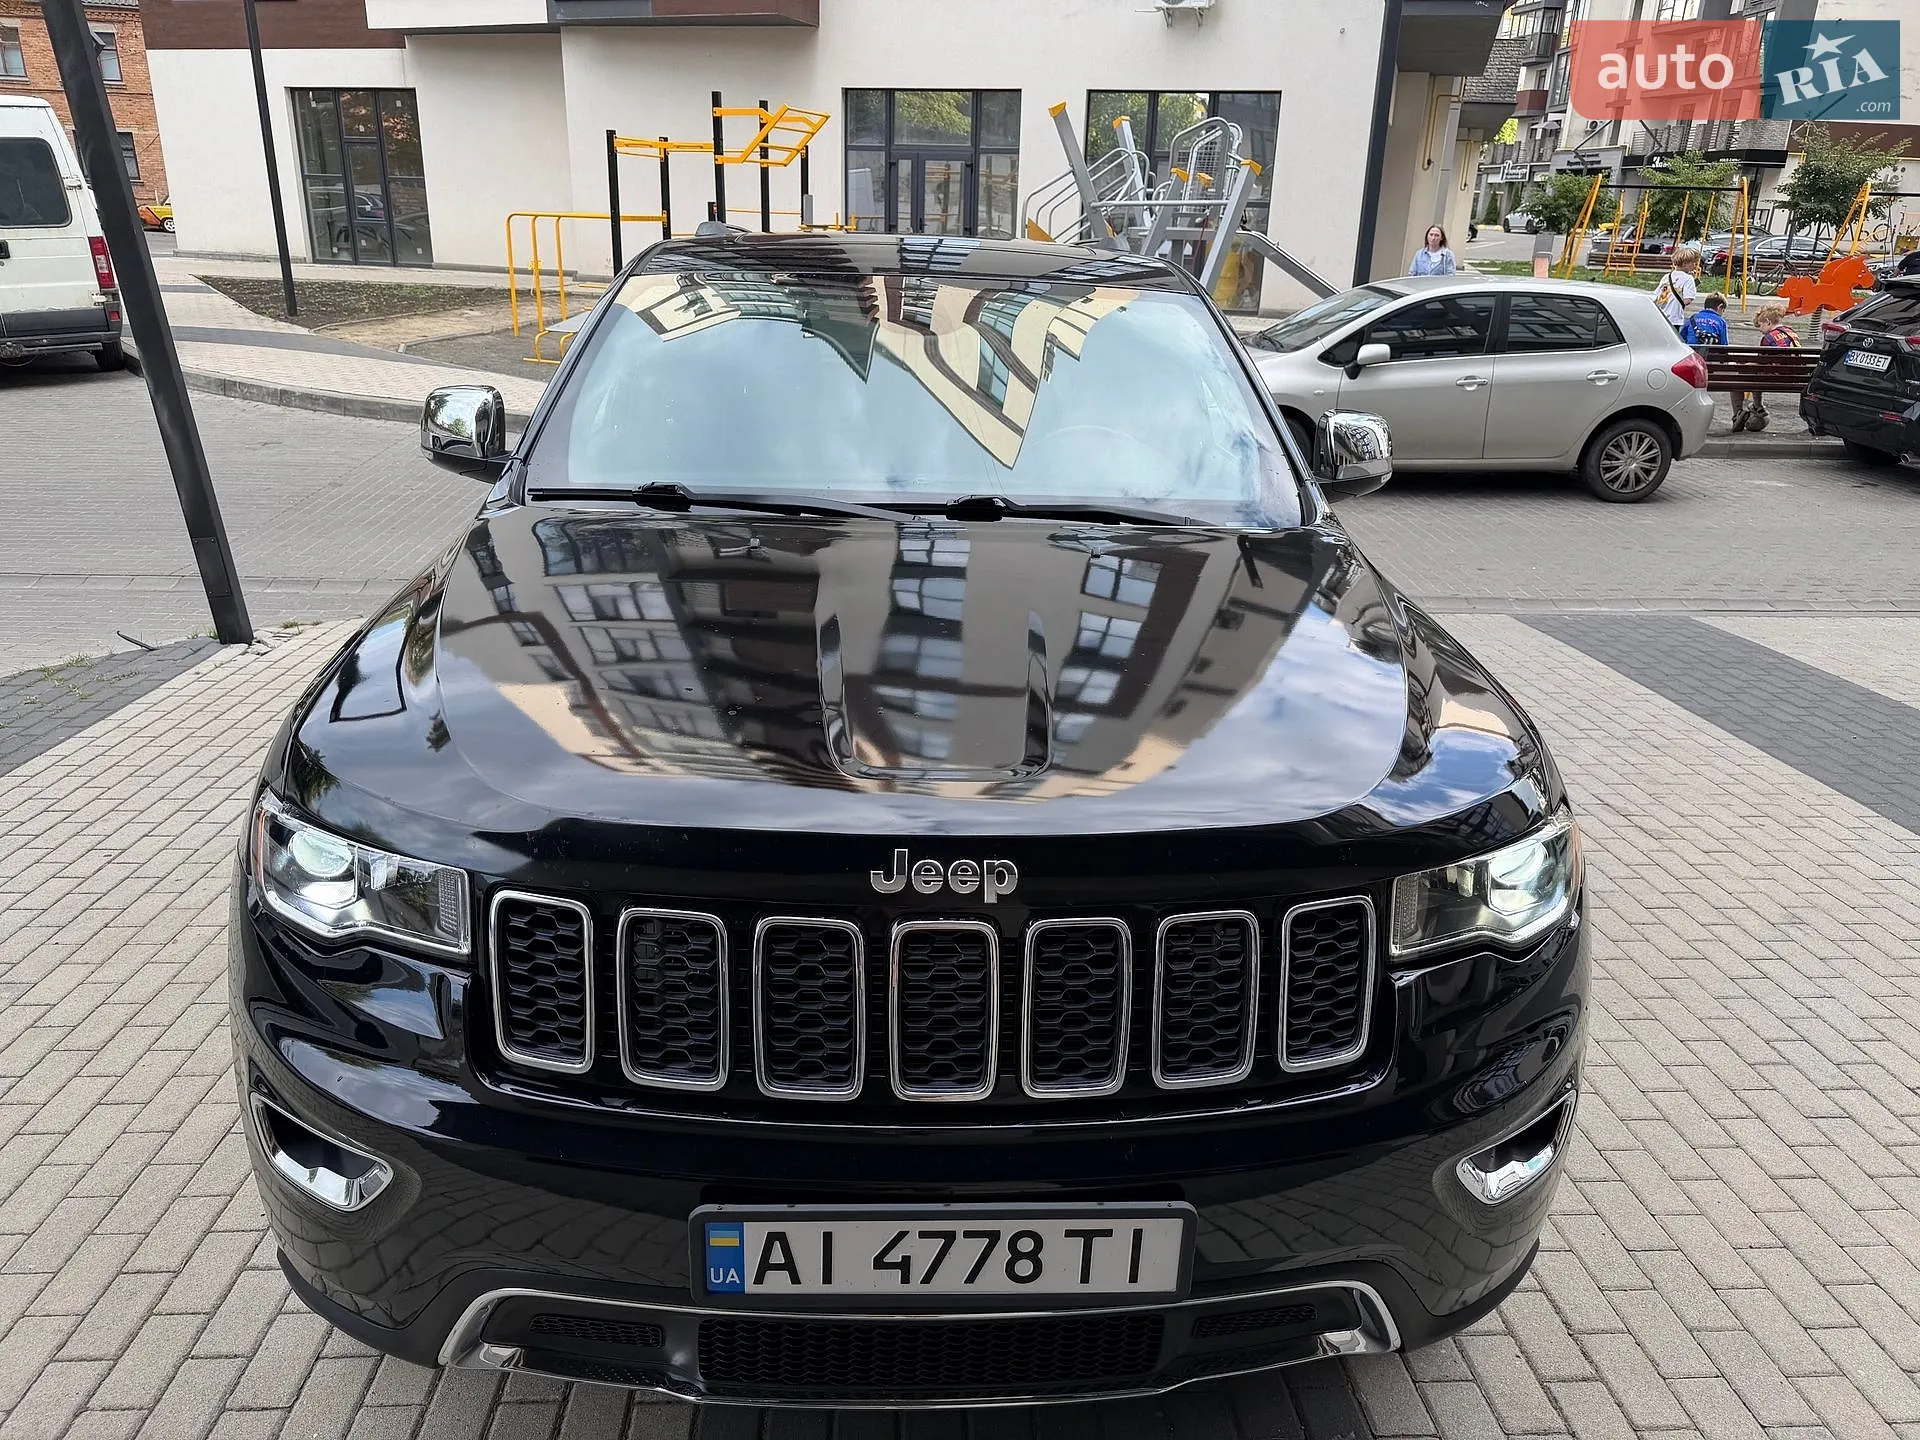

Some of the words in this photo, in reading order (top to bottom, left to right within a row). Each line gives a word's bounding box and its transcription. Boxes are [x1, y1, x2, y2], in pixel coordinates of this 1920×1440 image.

[1860, 354, 1877, 365] 0133
[1875, 357, 1888, 367] ET
[870, 848, 1018, 903] Jeep
[752, 1231, 833, 1285] AI
[872, 1230, 1044, 1284] 4778
[1063, 1228, 1143, 1284] TI
[710, 1267, 740, 1284] UA
